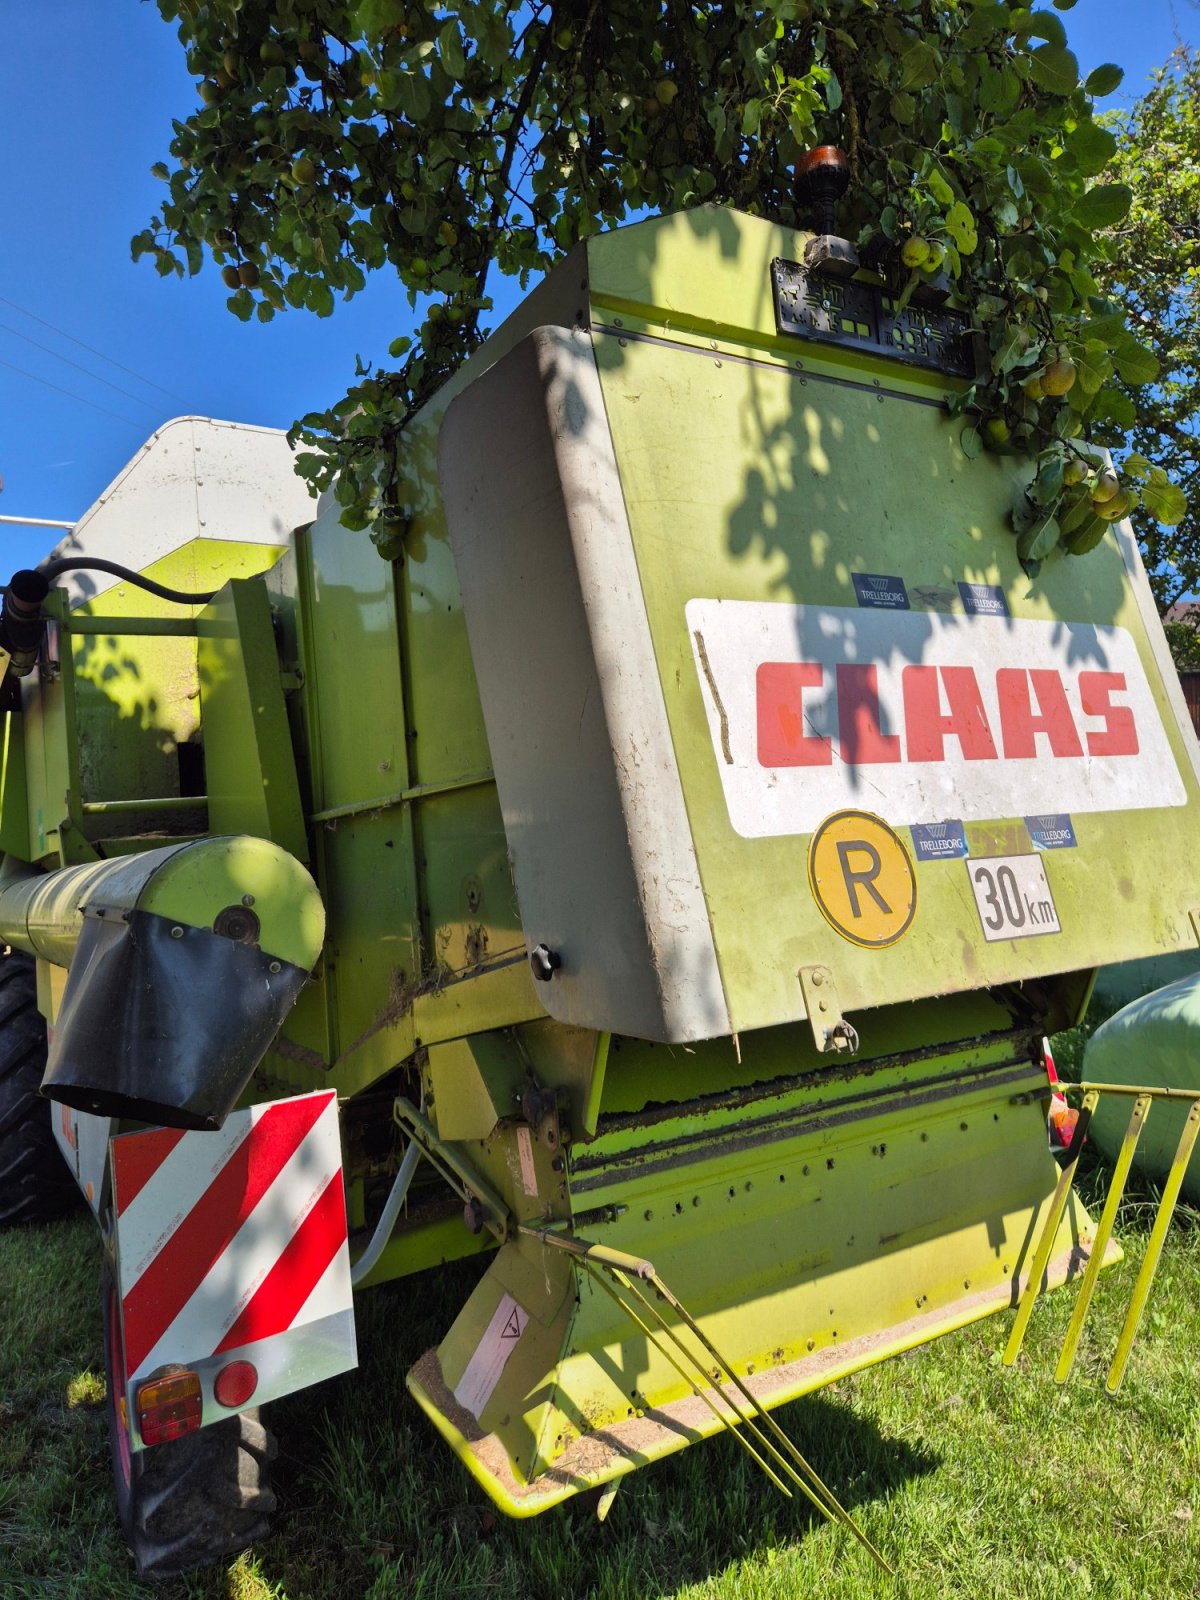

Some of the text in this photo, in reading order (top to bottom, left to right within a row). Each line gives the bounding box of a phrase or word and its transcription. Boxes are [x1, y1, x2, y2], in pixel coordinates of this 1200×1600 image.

[861, 590, 905, 603] TRELLEBORG
[966, 598, 1004, 610] TRELLEBORG
[755, 661, 1140, 768] CLAAS
[1033, 829, 1072, 841] TRELLEBORG
[919, 838, 963, 852] TRELLEBORG
[835, 839, 894, 919] R
[974, 864, 1055, 931] 30 km
